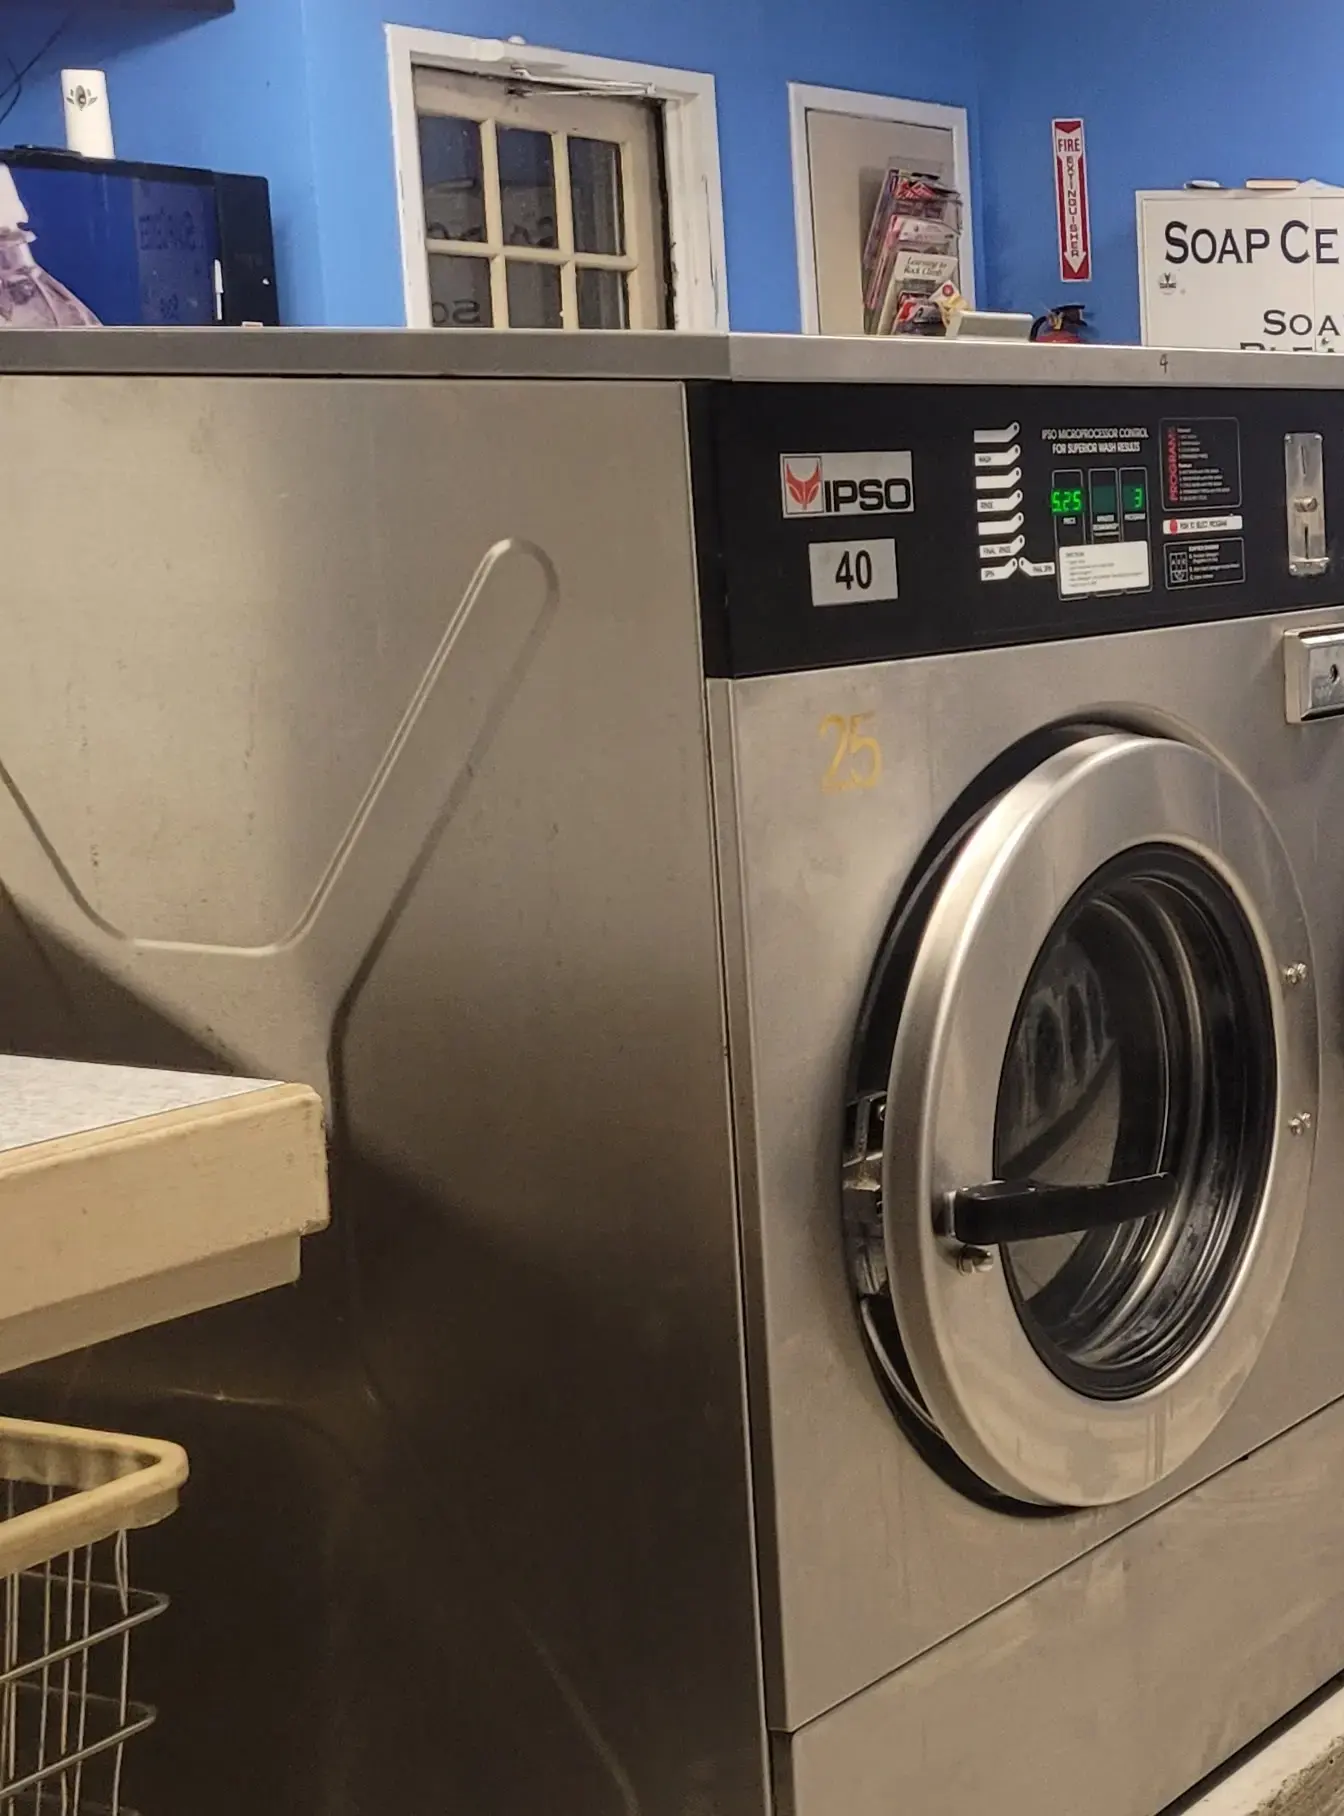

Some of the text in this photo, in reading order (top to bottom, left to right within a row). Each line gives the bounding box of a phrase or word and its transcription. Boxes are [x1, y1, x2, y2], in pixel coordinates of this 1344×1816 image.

[1058, 138, 1081, 152] FIRE
[1066, 155, 1079, 257] EXTINGUISHER
[824, 478, 911, 513] IPSO
[1134, 487, 1143, 508] 3
[835, 550, 872, 590] 40
[818, 710, 882, 797] 25
